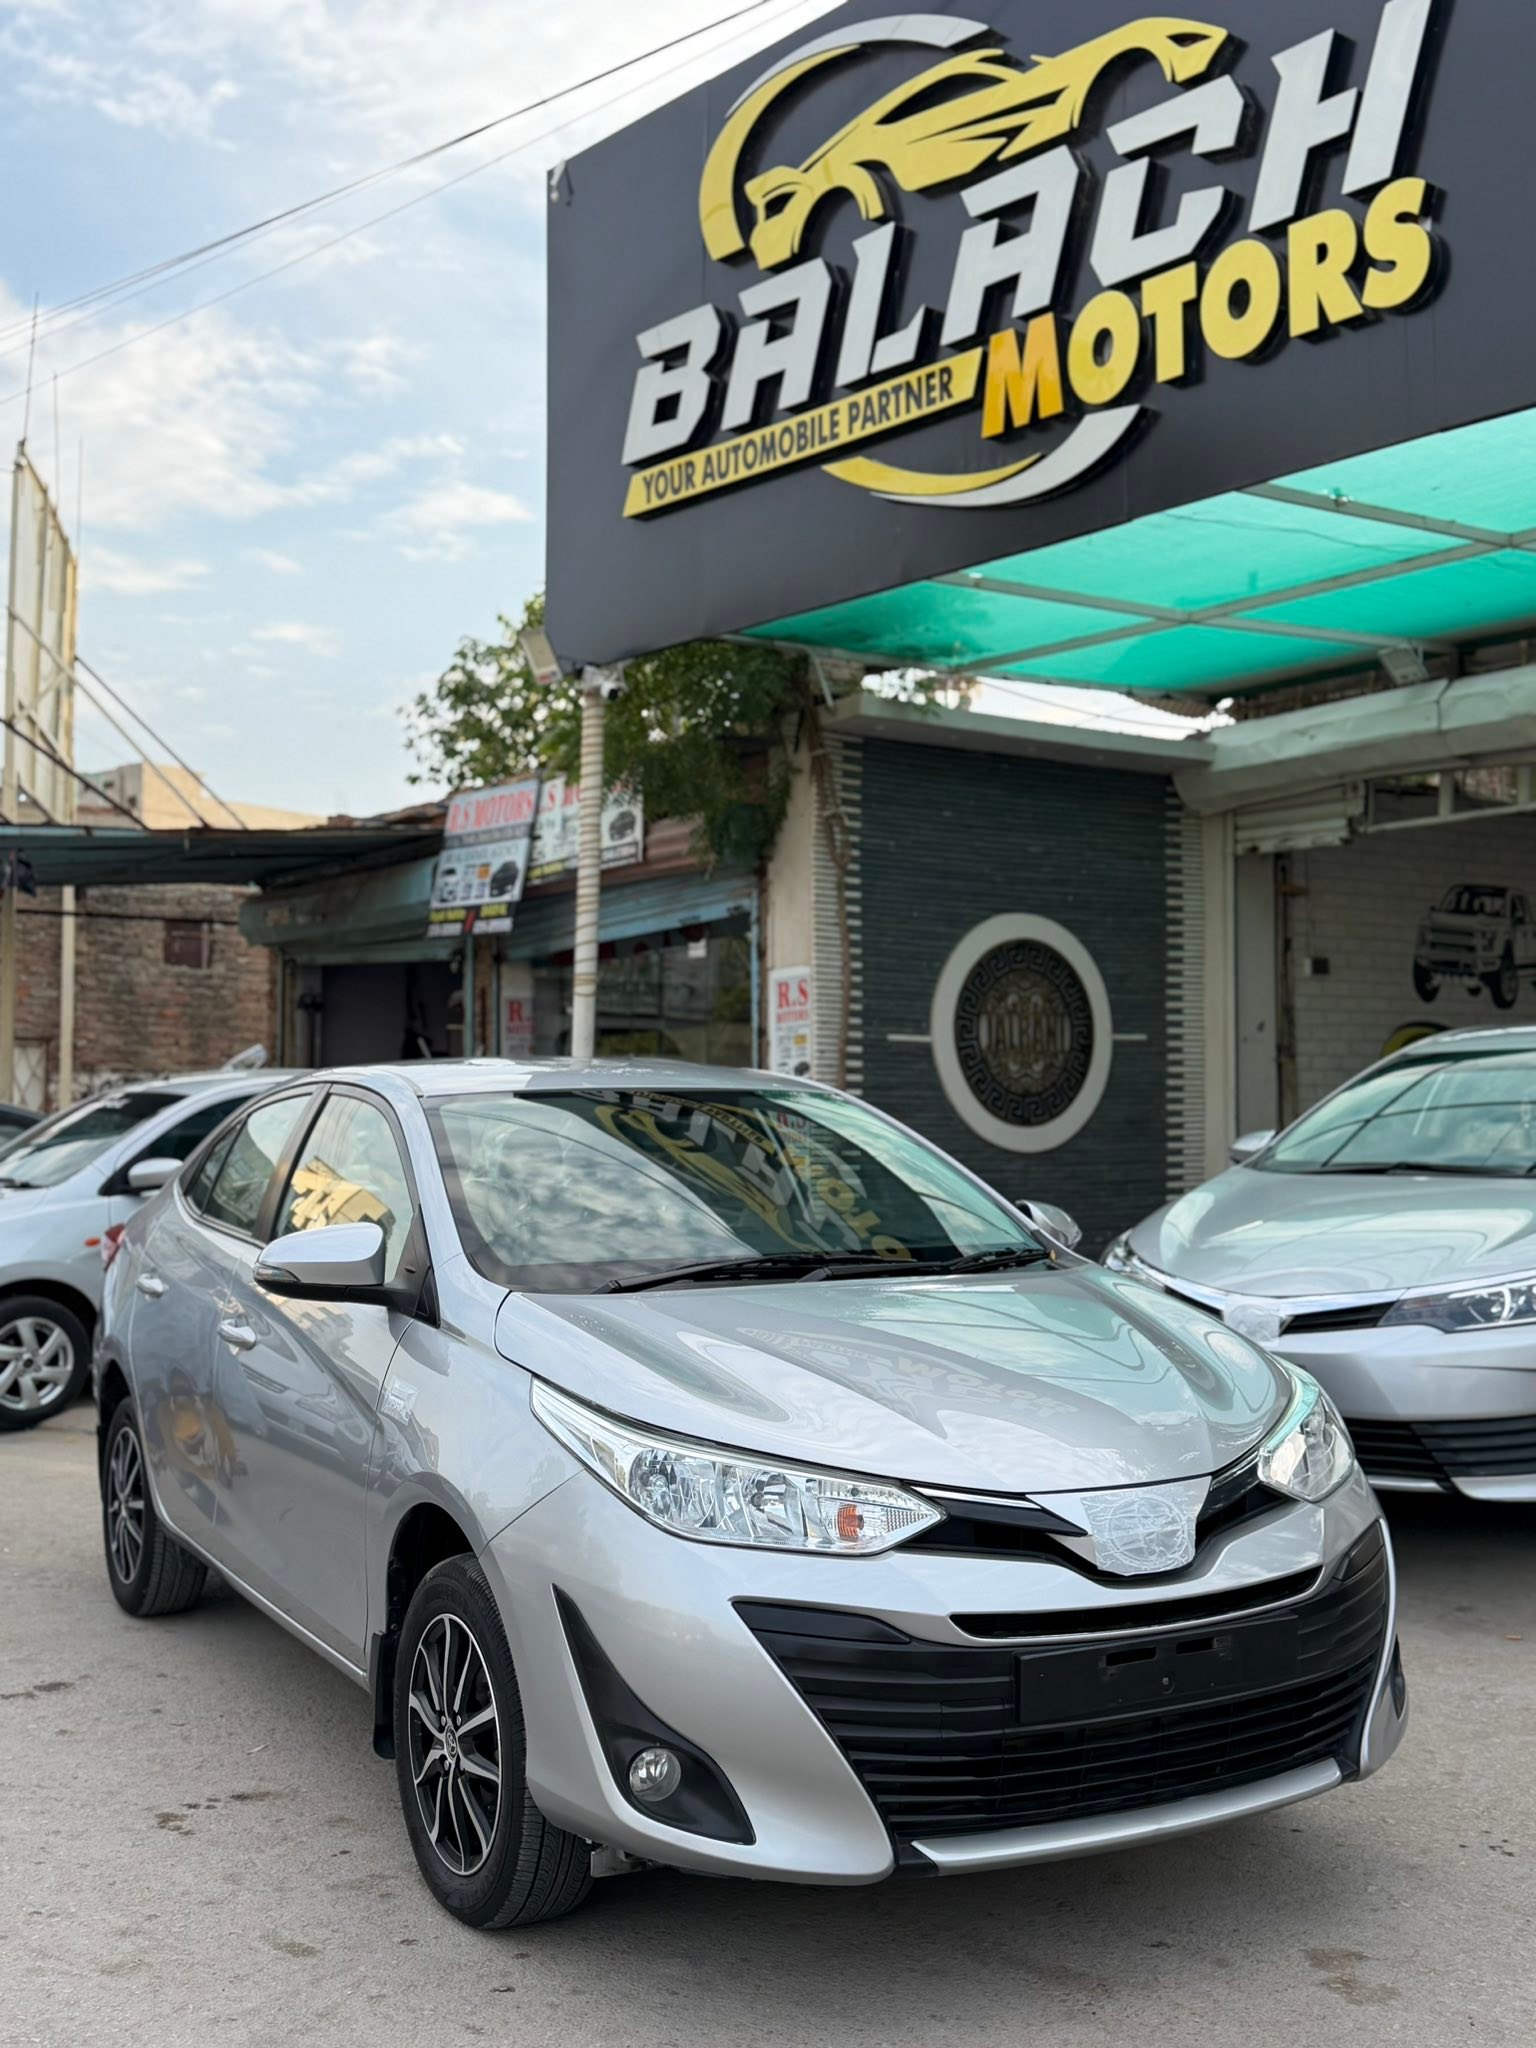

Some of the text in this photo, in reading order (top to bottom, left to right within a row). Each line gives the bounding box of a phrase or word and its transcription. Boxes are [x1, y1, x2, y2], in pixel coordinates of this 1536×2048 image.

[622, 0, 1431, 465] BALACH
[981, 177, 1433, 439] MOTORS
[643, 366, 954, 504] YOUR AUTOMOBILE PARTNER
